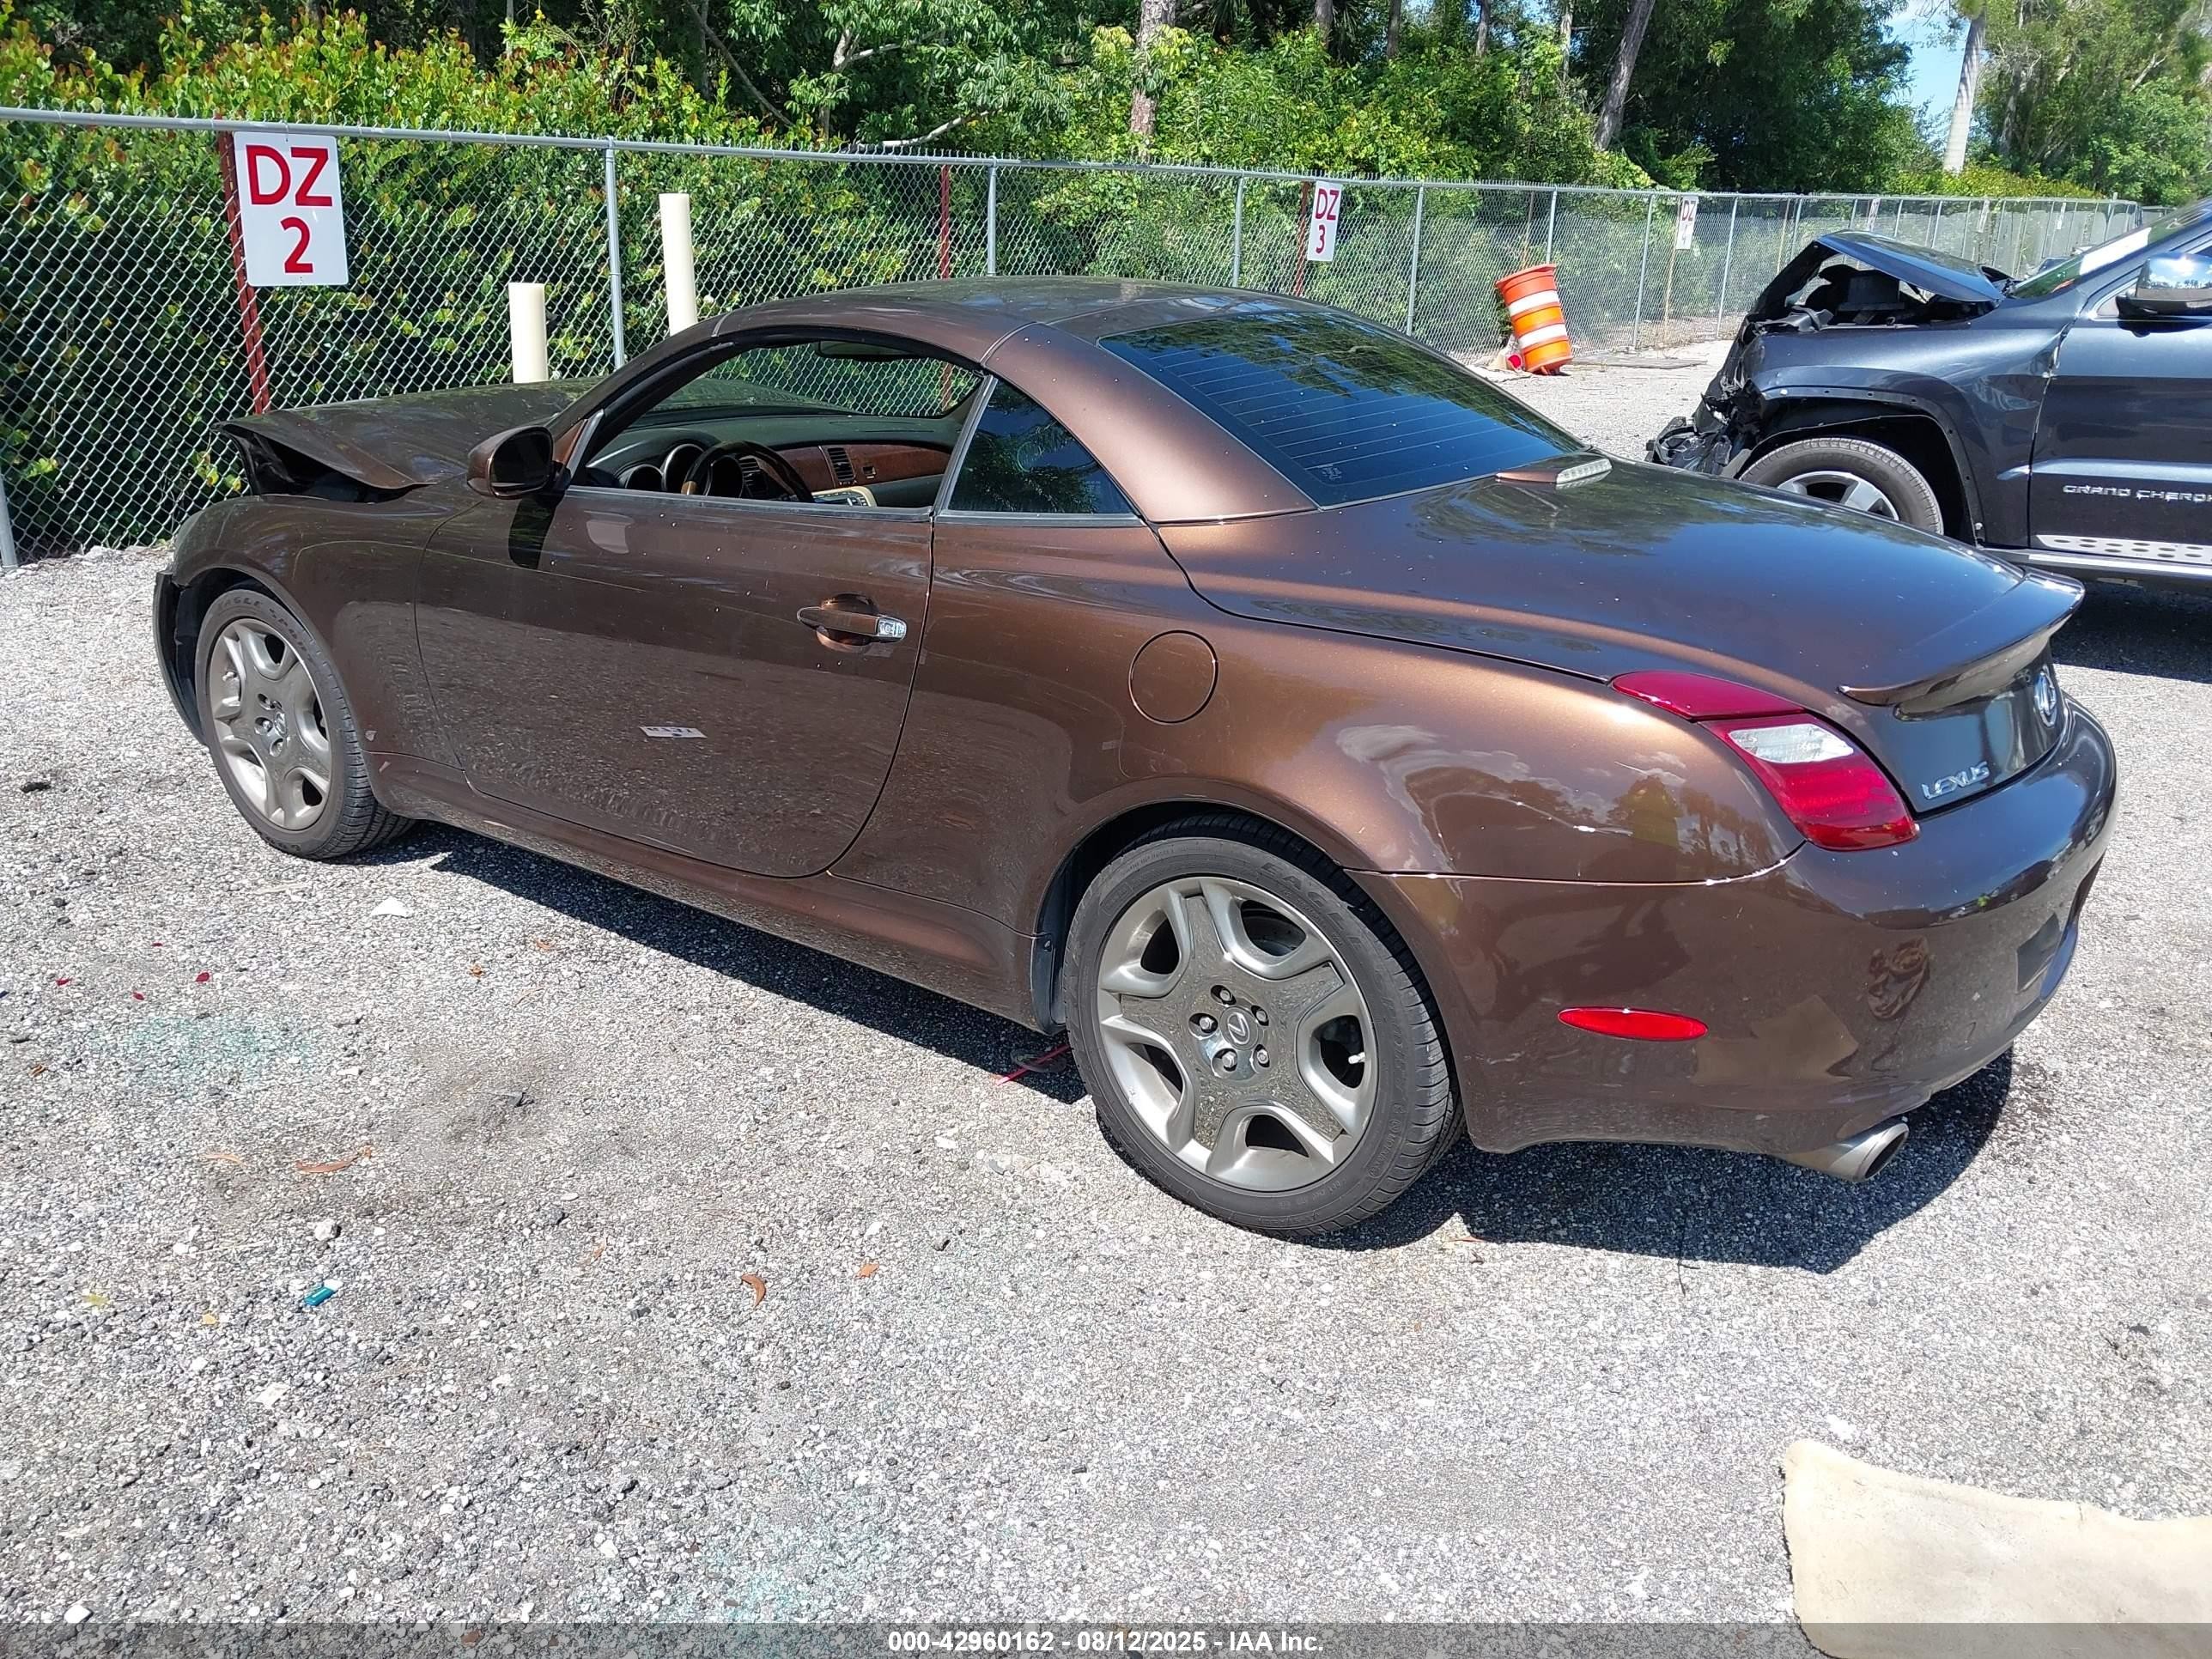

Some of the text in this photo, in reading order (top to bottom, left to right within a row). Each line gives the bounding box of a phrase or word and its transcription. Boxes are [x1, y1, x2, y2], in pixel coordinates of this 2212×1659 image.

[246, 144, 333, 207] DZ
[1315, 187, 1340, 221] DZ
[1681, 200, 1697, 222] DZ
[280, 216, 314, 274] 2
[1315, 224, 1326, 253] 3
[2063, 485, 2131, 497] GRAND
[1922, 761, 1990, 800] LEXUS
